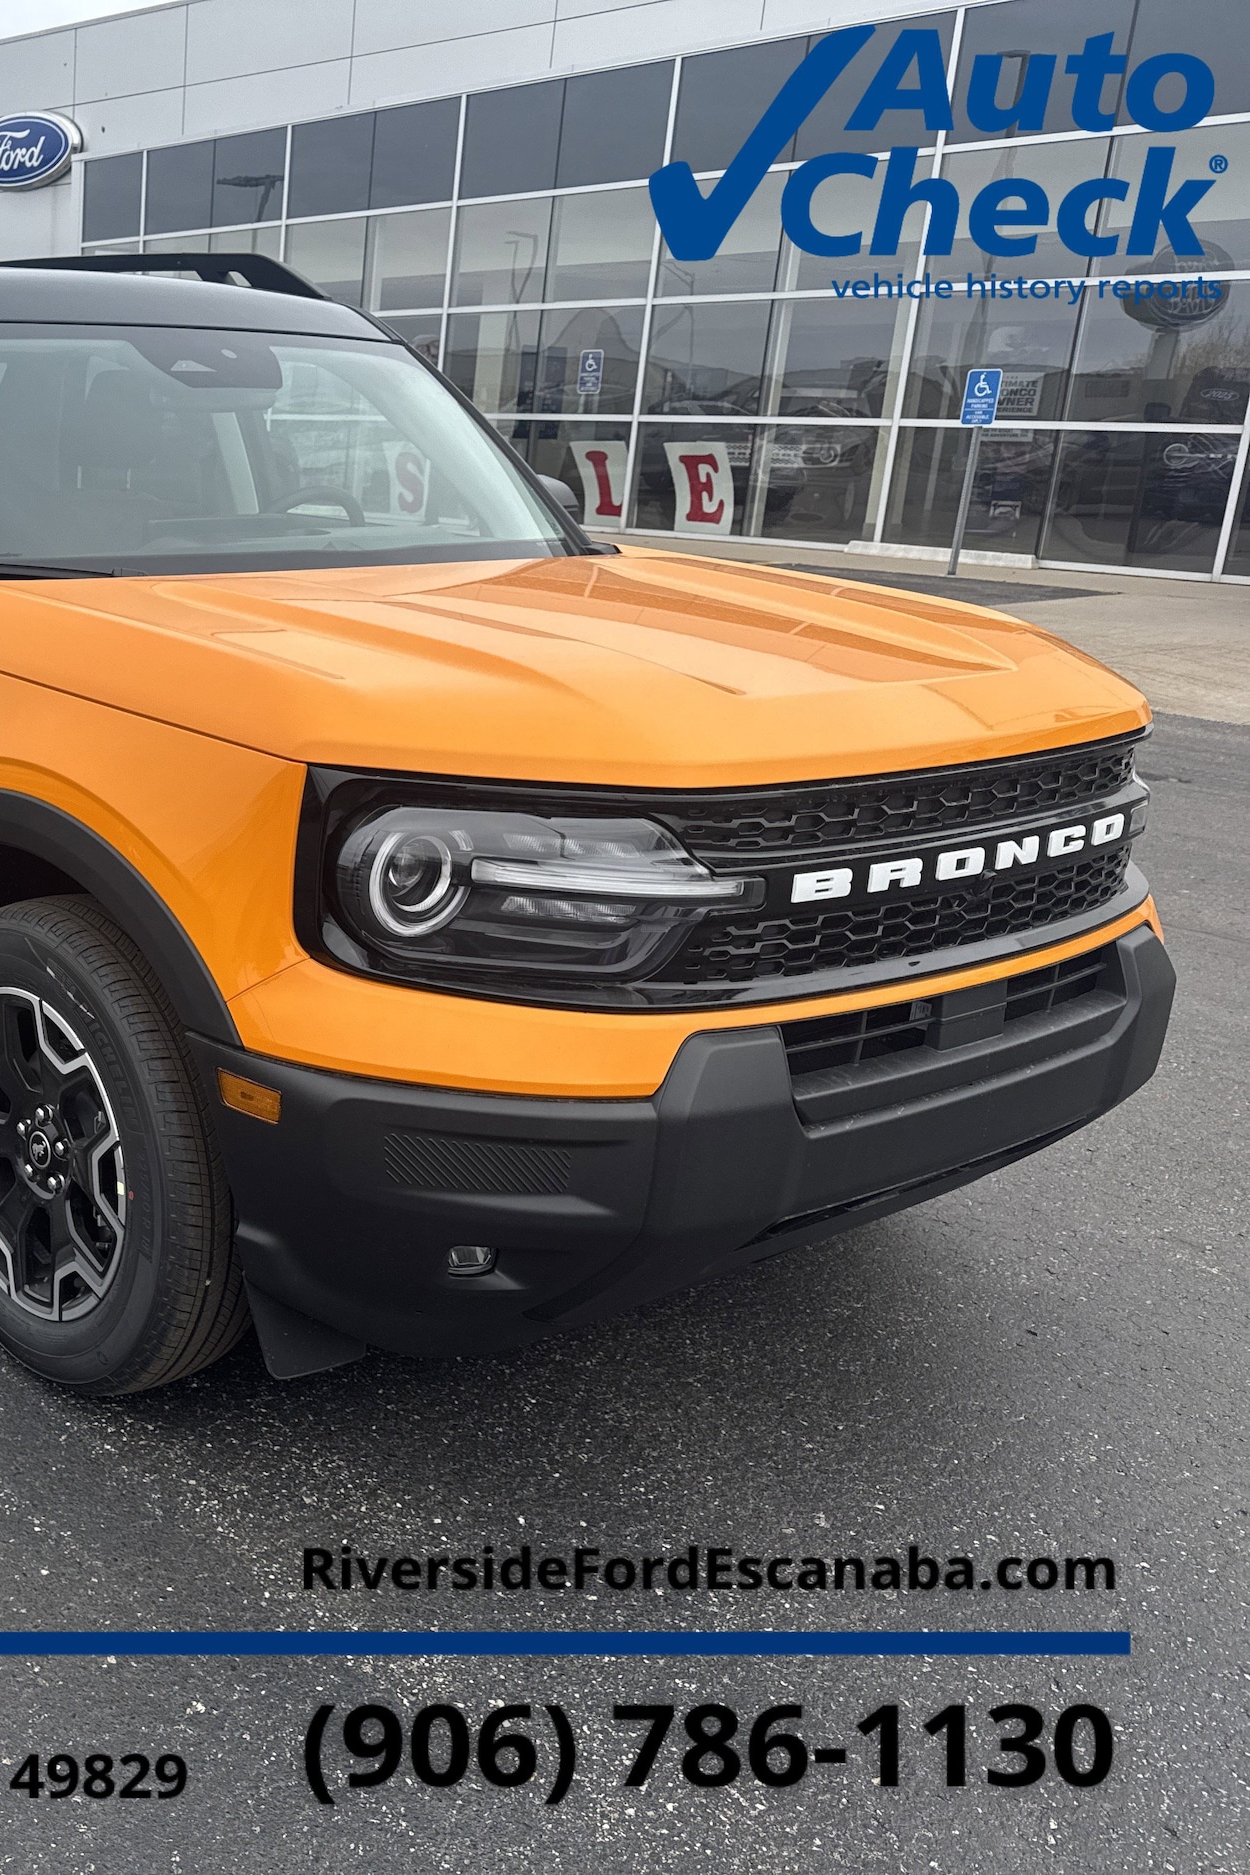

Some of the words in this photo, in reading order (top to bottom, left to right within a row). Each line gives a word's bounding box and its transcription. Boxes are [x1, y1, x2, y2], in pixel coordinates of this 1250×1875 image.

[1000, 388, 1037, 397] ONCO
[584, 450, 623, 517] L
[678, 453, 725, 525] E
[790, 812, 1125, 904] BRONCO
